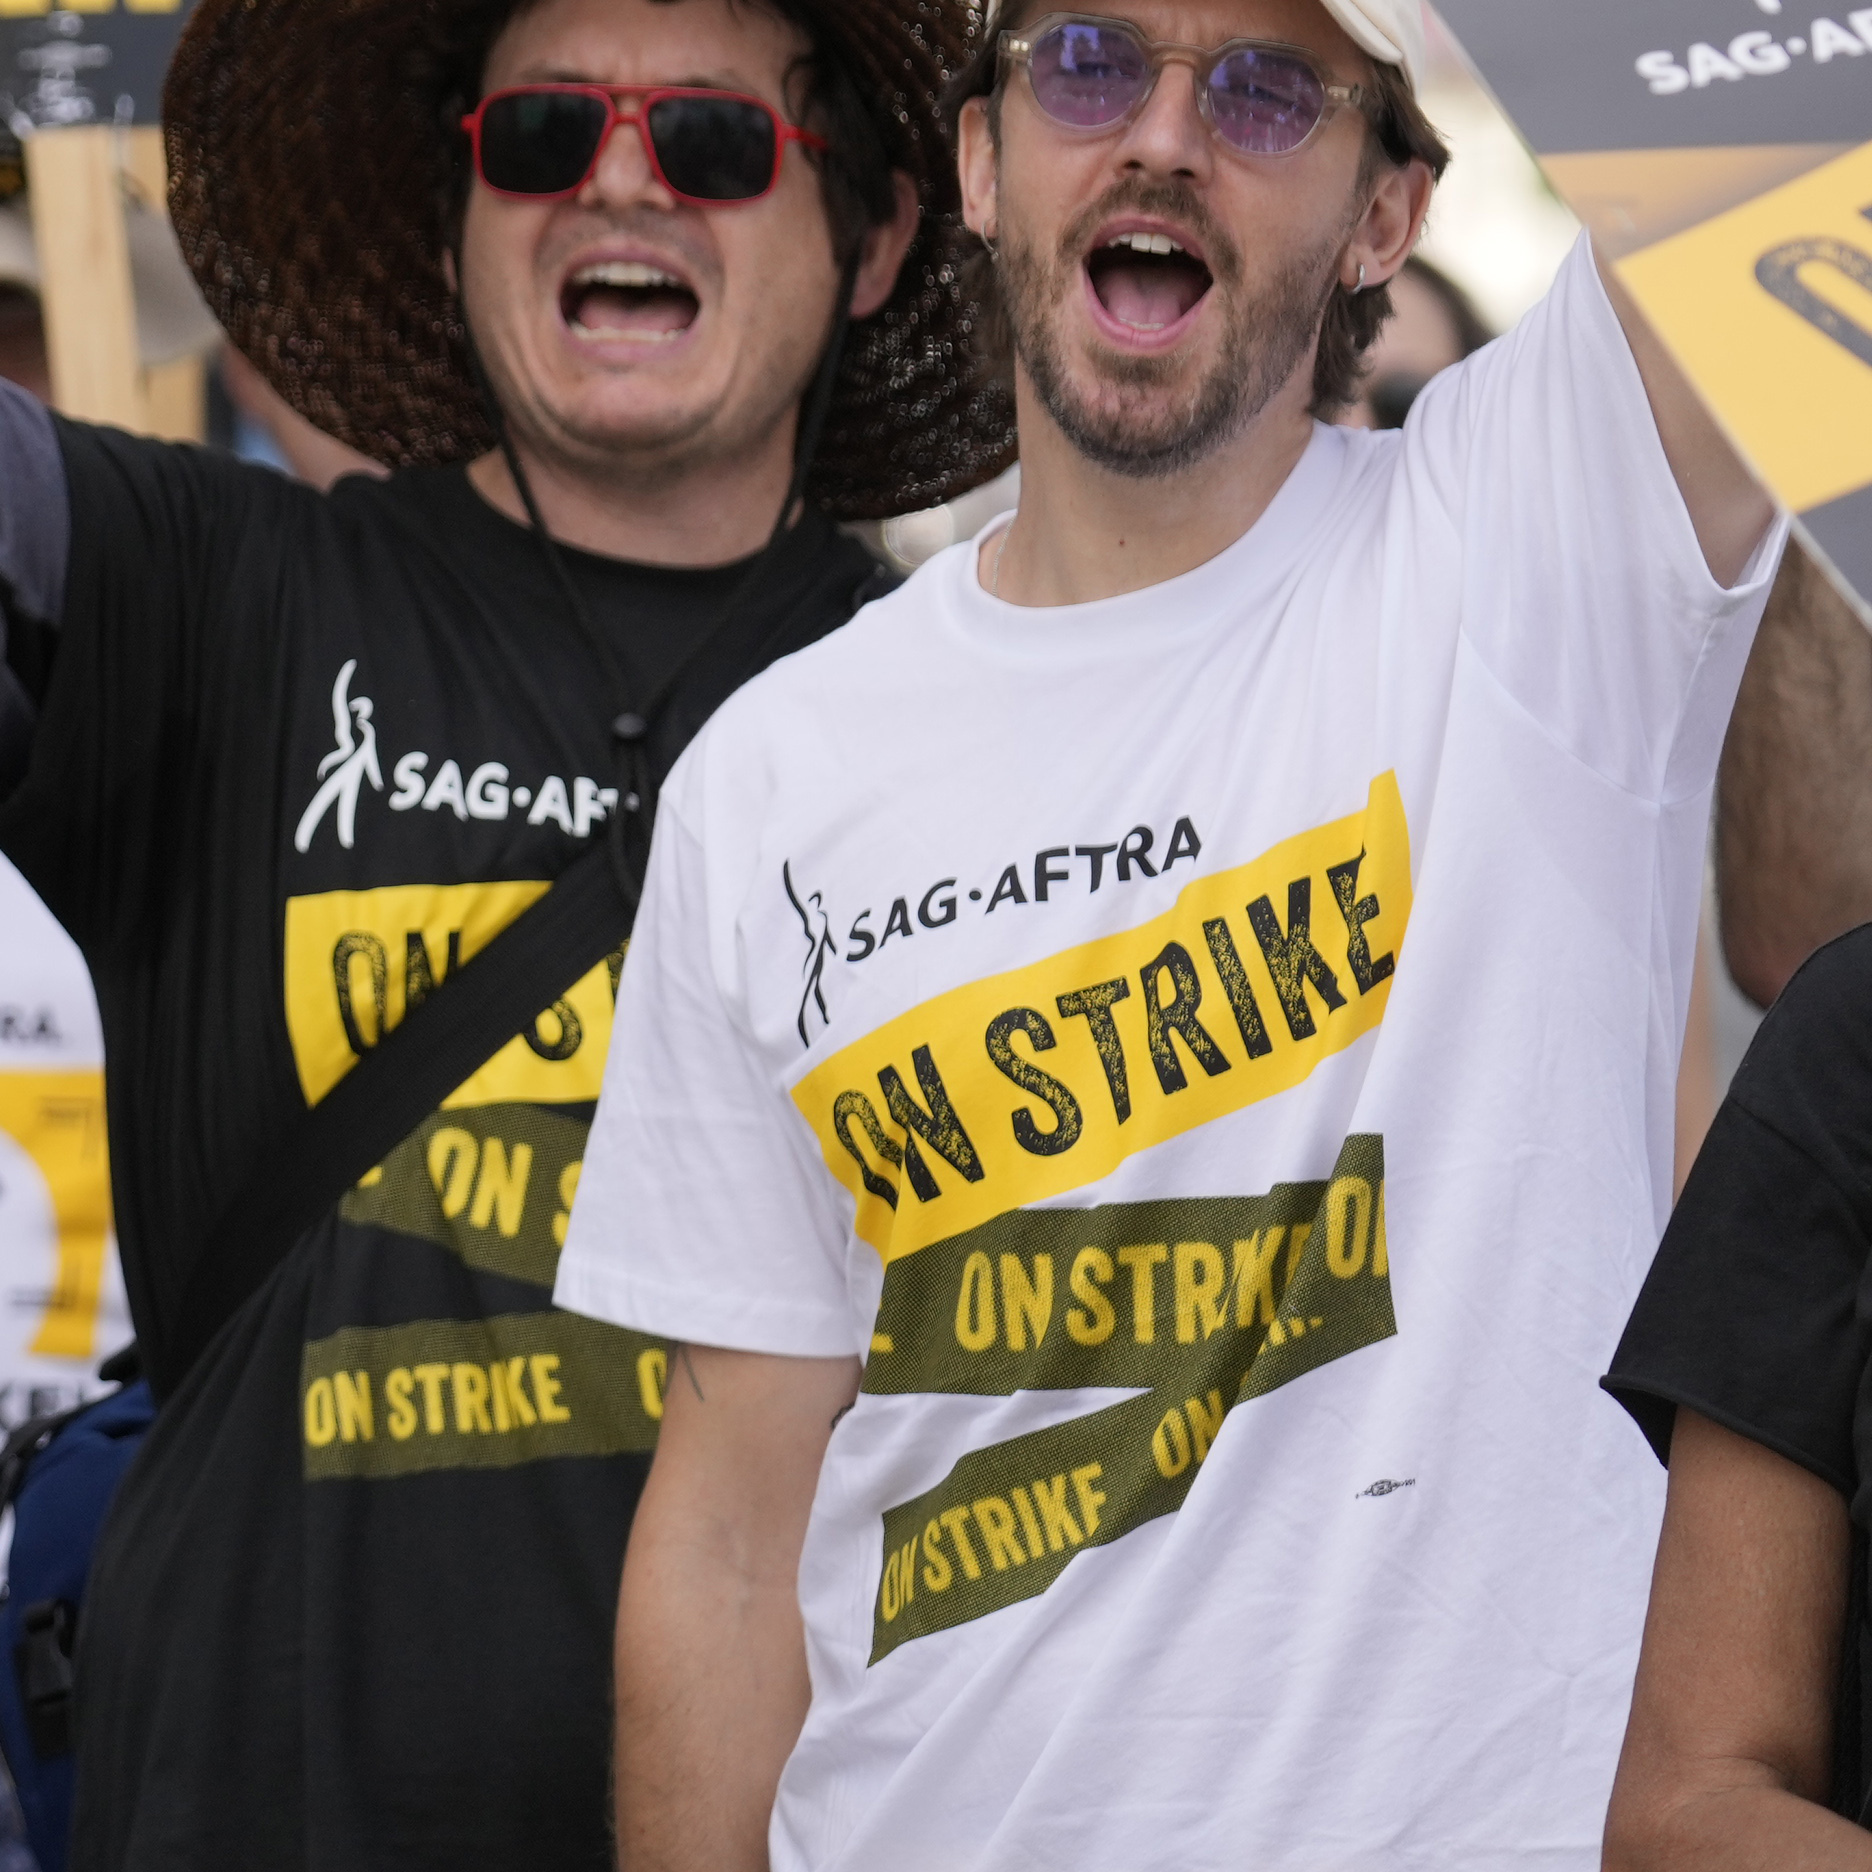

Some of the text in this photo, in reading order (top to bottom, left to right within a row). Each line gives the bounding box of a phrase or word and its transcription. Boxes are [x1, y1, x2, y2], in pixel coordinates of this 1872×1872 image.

[833, 850, 1396, 1213] ON STRIKE
[426, 1126, 534, 1239] ON
[953, 1249, 1055, 1352] ON
[303, 1368, 377, 1449] ON
[385, 1352, 573, 1439] STRIKE
[879, 1531, 920, 1624] ON
